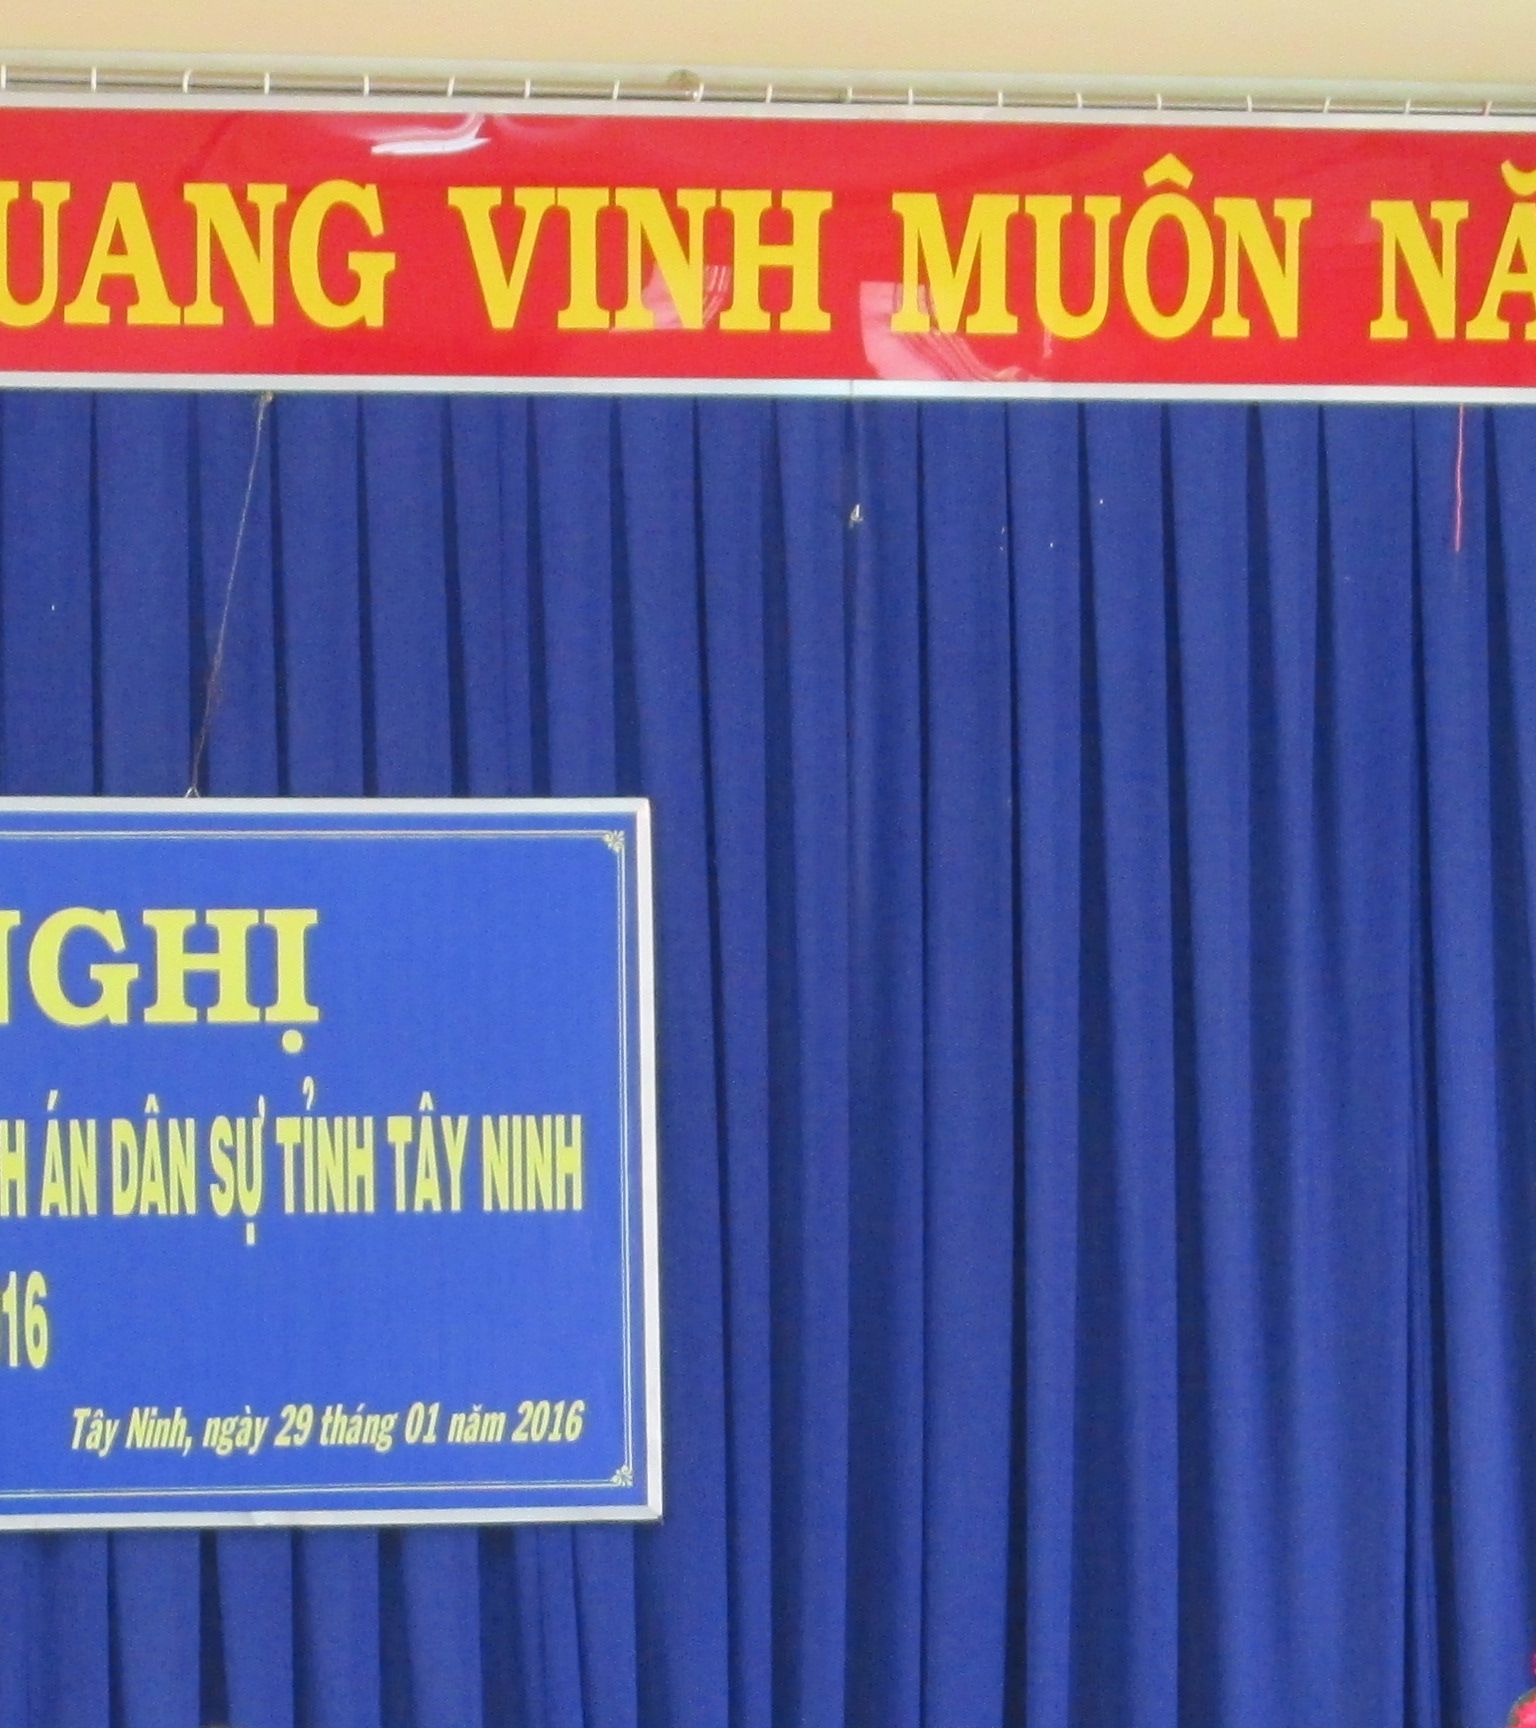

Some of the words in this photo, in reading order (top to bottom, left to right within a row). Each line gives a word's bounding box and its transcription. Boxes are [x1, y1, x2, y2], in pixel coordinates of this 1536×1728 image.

[448, 187, 833, 333] VINH
[891, 155, 1312, 342] MUÔN
[40, 1090, 98, 1217] ÁN
[111, 1094, 196, 1216] DÂN
[210, 1095, 265, 1245] SỰ
[276, 1076, 376, 1214] TỈNH
[387, 1092, 469, 1212] TÂY
[482, 1114, 584, 1212] NINH
[72, 1408, 119, 1457] Tây
[125, 1407, 193, 1456] Ninh,
[202, 1406, 269, 1456] ngày
[274, 1404, 313, 1446] 29
[320, 1403, 398, 1452] tháng
[405, 1402, 440, 1444] 01
[448, 1405, 506, 1444] năm
[511, 1400, 586, 1443] 2016
